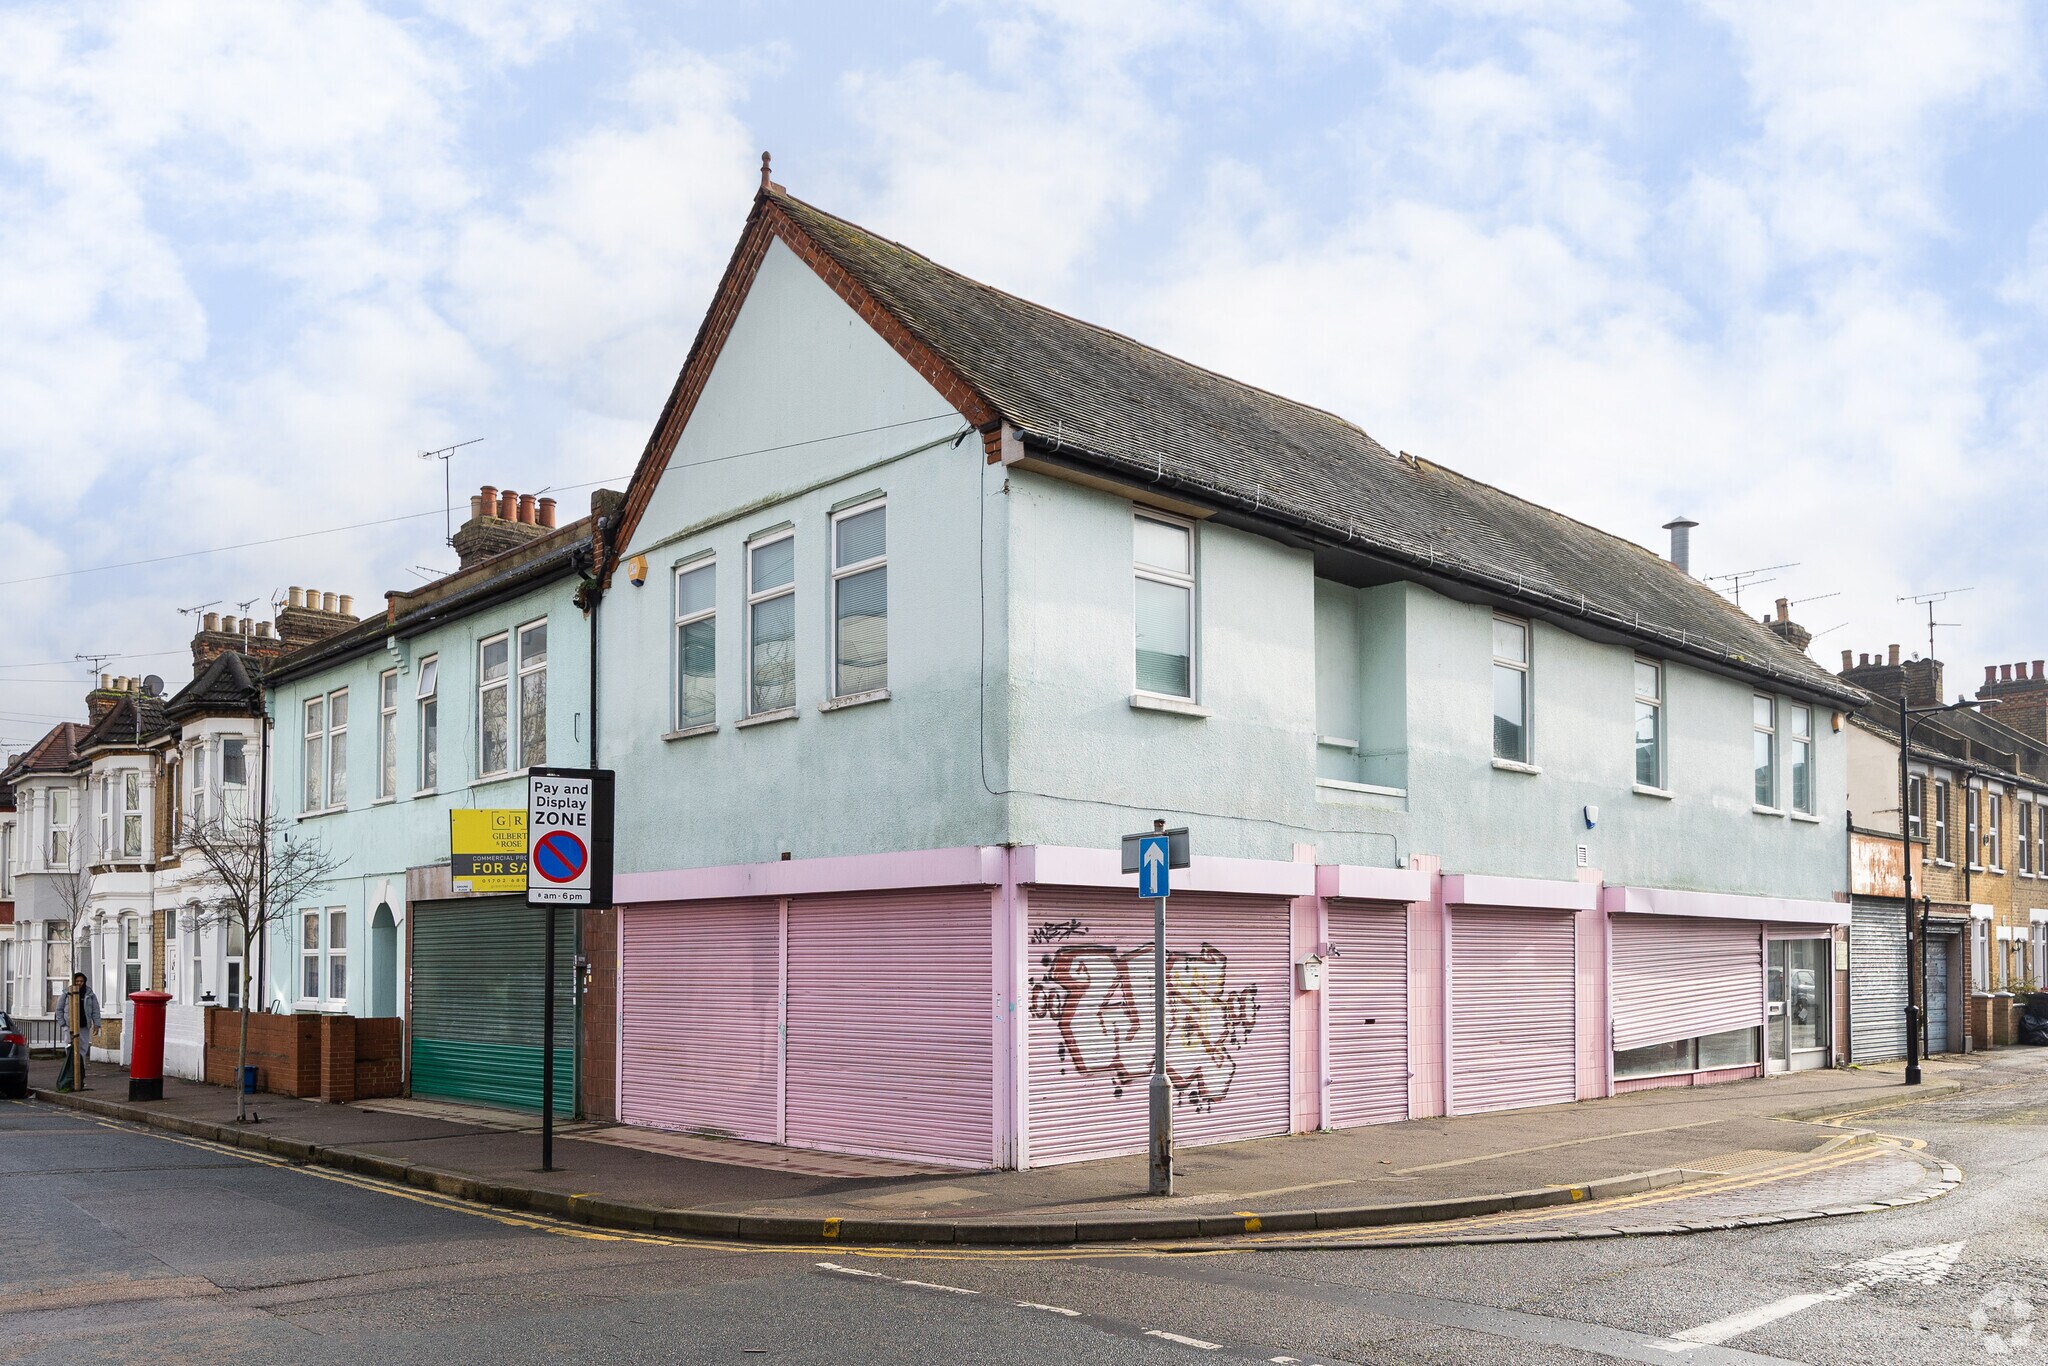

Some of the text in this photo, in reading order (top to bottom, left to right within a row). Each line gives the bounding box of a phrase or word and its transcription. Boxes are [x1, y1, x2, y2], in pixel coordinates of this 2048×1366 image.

[534, 781, 588, 796] Pay and
[536, 796, 586, 811] Display
[535, 811, 587, 826] ZONE
[492, 832, 528, 840] GILBERT
[501, 840, 523, 848] ROSE
[472, 862, 528, 874] FOR SA
